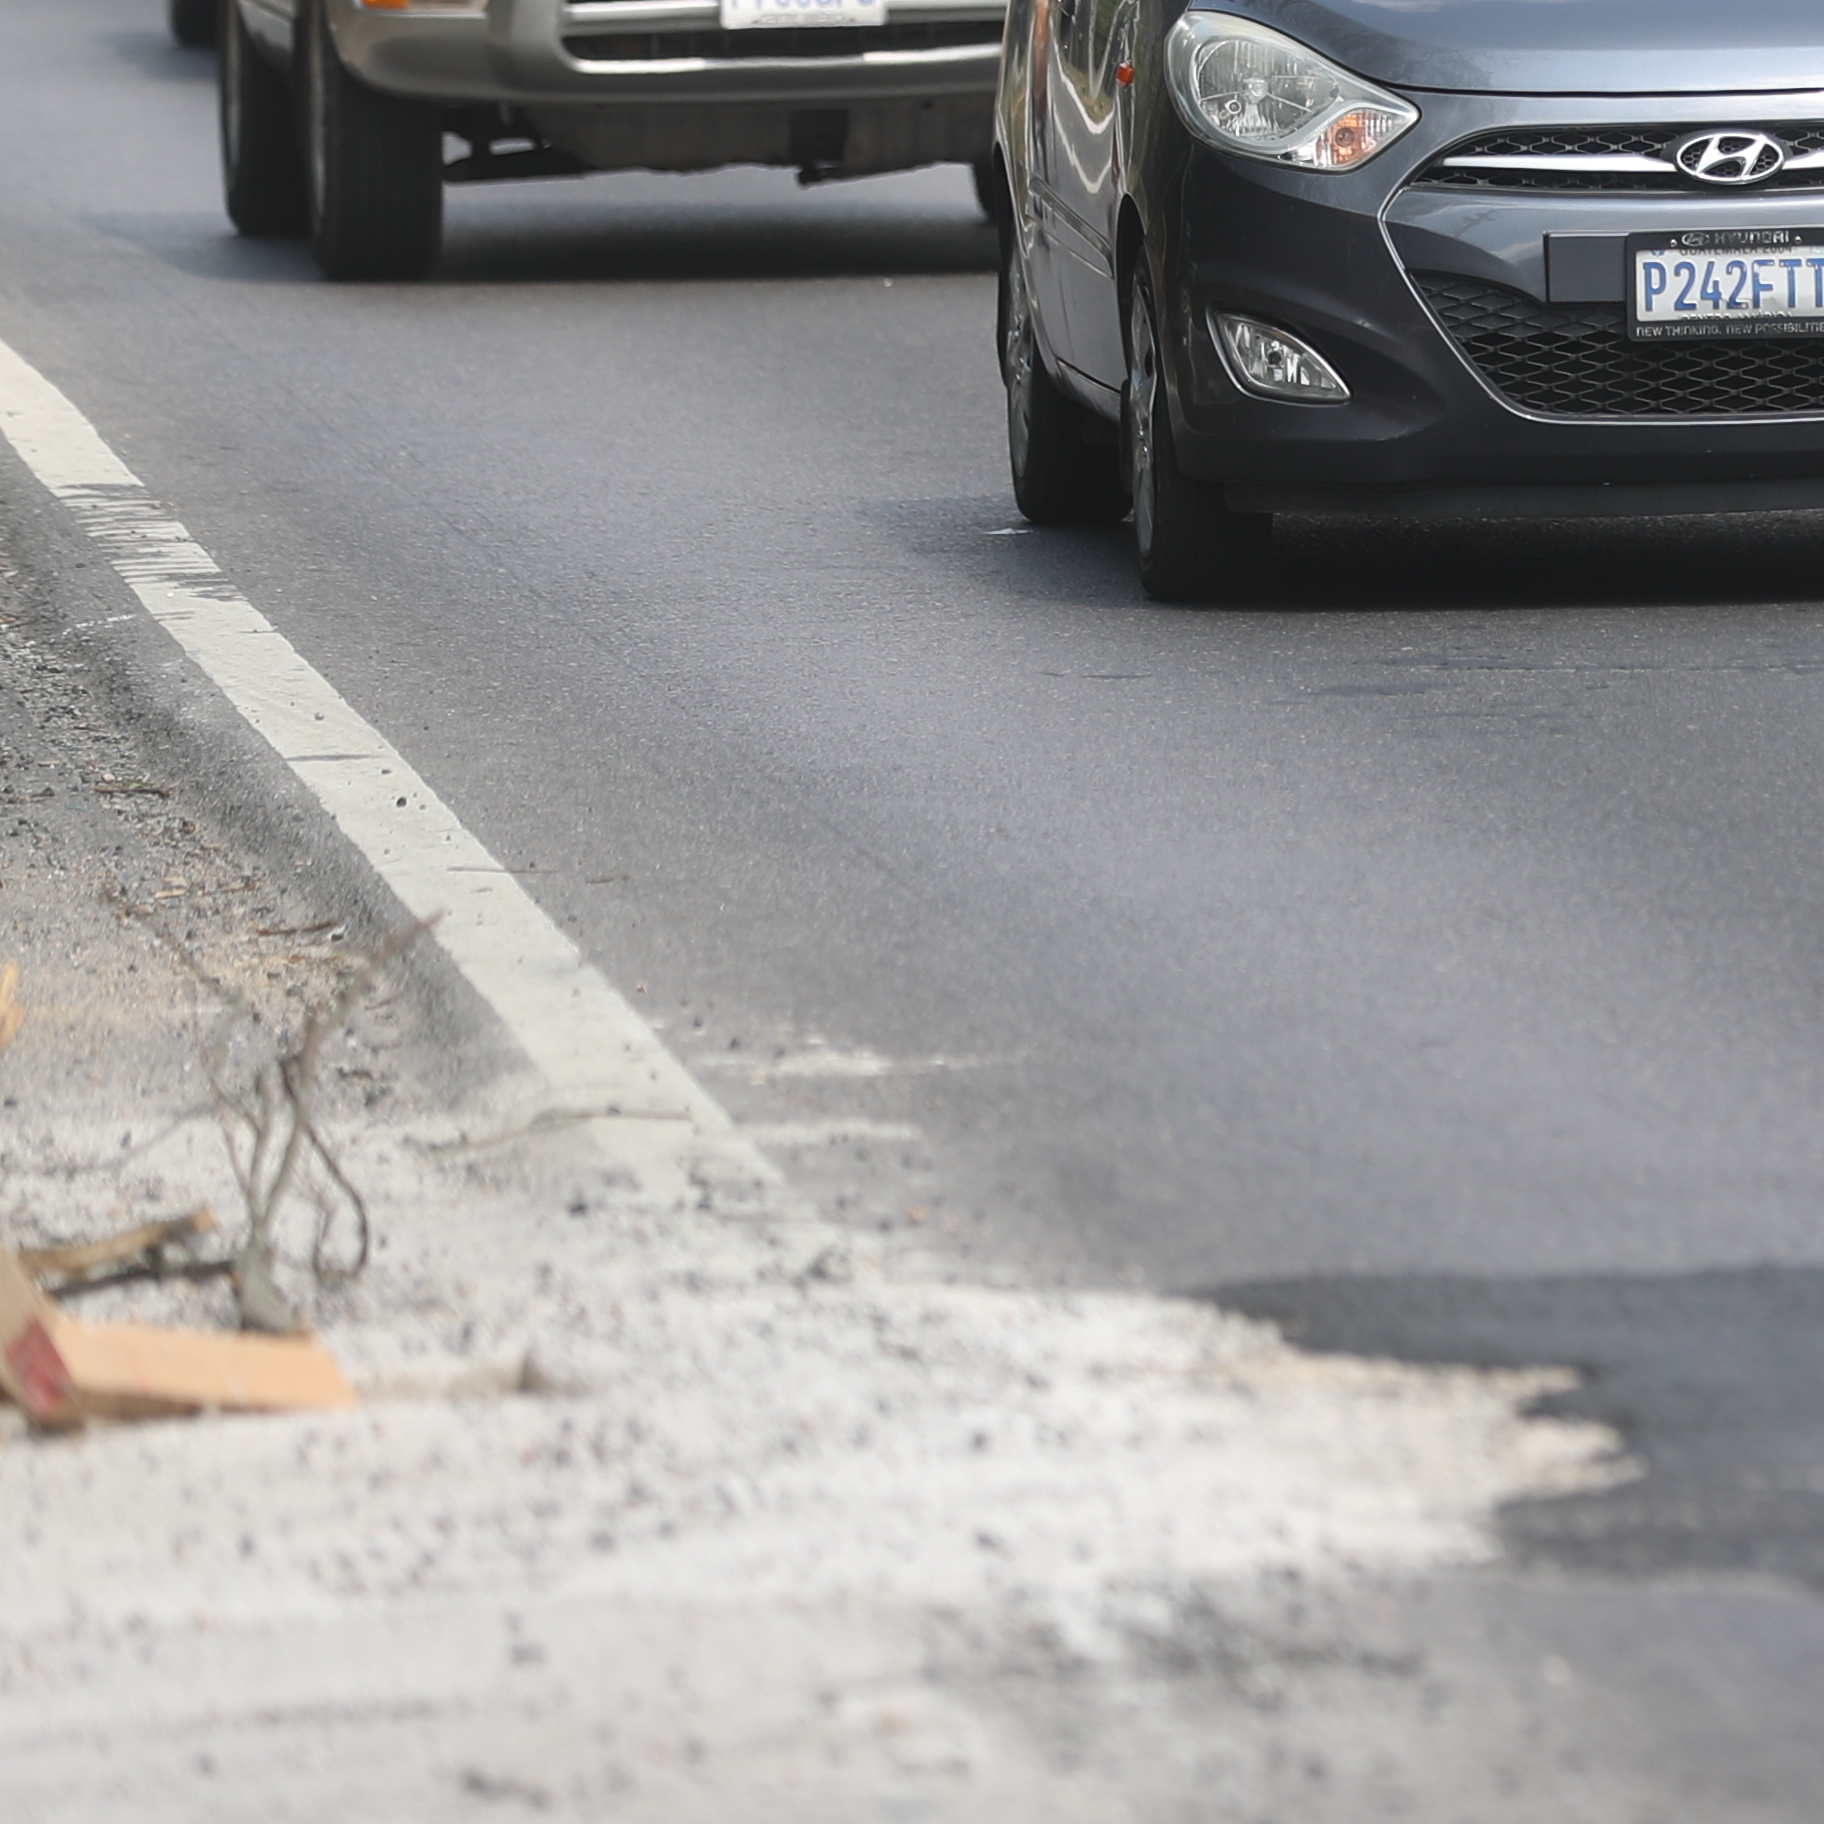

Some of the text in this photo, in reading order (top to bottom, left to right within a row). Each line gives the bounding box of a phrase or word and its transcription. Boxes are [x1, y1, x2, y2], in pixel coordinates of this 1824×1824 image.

[1715, 230, 1789, 245] HYUNDAI
[1636, 326, 1663, 337] NEW
[1726, 323, 1753, 334] NEW
